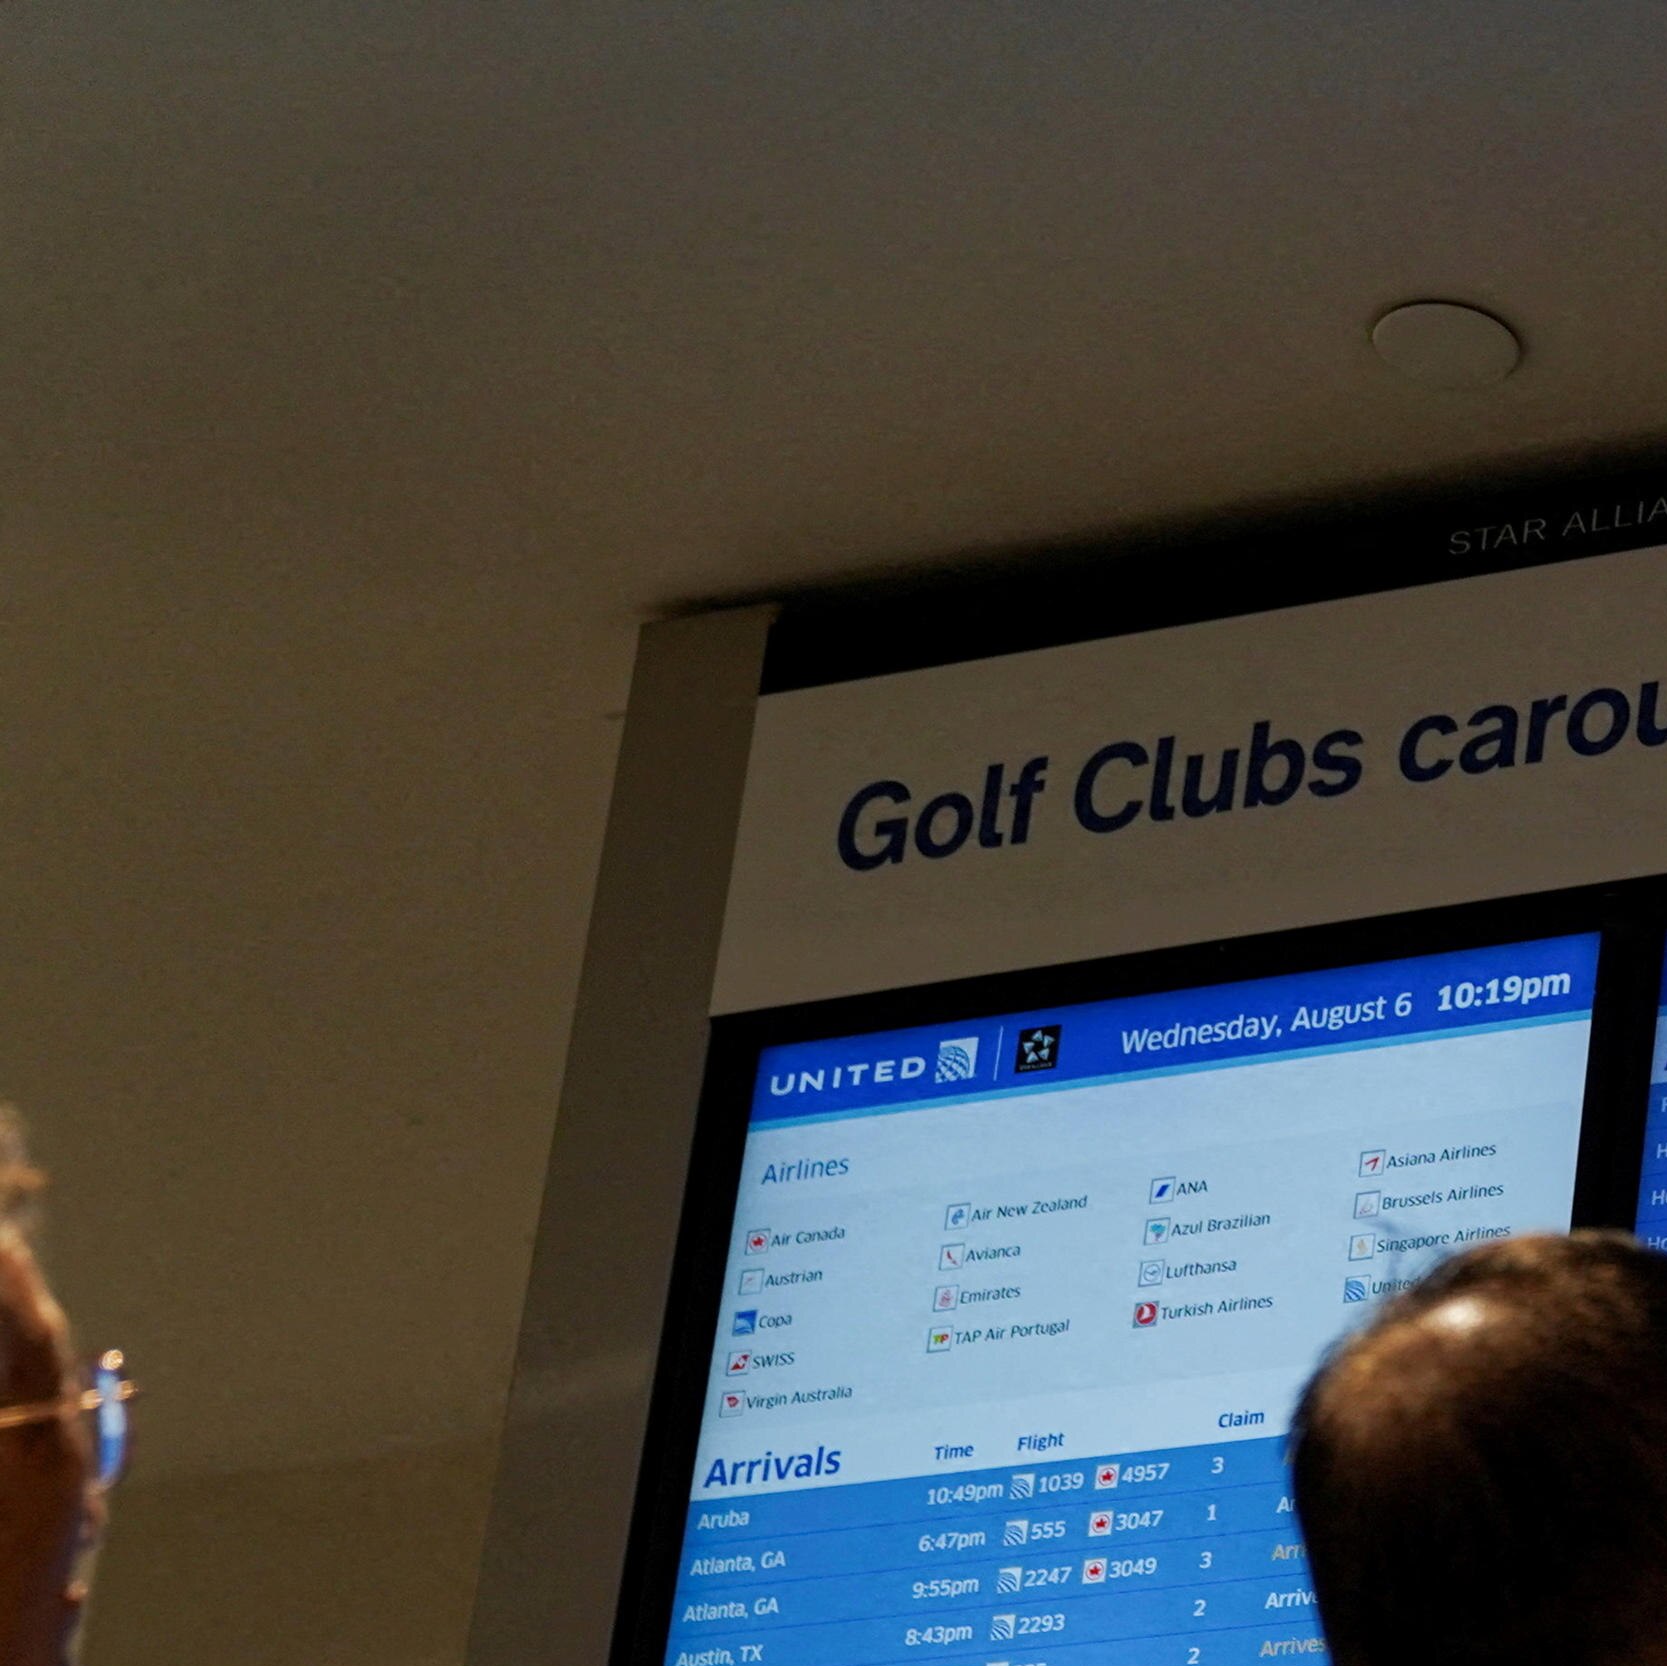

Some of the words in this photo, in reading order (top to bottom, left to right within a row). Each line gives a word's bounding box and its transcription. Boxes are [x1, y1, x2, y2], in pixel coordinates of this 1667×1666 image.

[1449, 518, 1545, 556] STAR
[837, 756, 1048, 870] Golf
[1072, 720, 1363, 835] Clubs
[1121, 1013, 1283, 1055] Wednesday,
[1289, 995, 1388, 1032] August
[1394, 991, 1413, 1018] 6
[1437, 972, 1572, 1012] 10:19pm
[770, 1056, 927, 1096] UNITED
[1385, 1152, 1436, 1169] Asiana
[1439, 1144, 1497, 1162] Airlines
[760, 1157, 850, 1185] Airlines
[1176, 1179, 1208, 1196] ANA
[1381, 1190, 1444, 1211] Brussels
[1446, 1184, 1505, 1202] Airlines
[970, 1208, 993, 1222] Air
[996, 1204, 1029, 1219] New
[1031, 1194, 1089, 1215] Zealand
[770, 1233, 792, 1248] Air
[795, 1225, 846, 1245] Canada
[1170, 1219, 1204, 1237] Azul
[1207, 1214, 1271, 1233] Brazilian
[1376, 1231, 1450, 1254] Singapore
[1453, 1225, 1511, 1243] Airlines
[964, 1245, 1022, 1263] Avianca
[764, 1269, 824, 1288] Austrian
[1165, 1259, 1238, 1280] Lufthansa
[959, 1286, 1021, 1305] Emirates
[1160, 1301, 1214, 1321] Turkish
[1216, 1296, 1274, 1314] Airlines
[758, 1314, 793, 1329] Copa
[954, 1329, 983, 1345] TAP
[984, 1326, 1007, 1342] Air
[1010, 1318, 1071, 1339] Portugal
[752, 1351, 795, 1370] SWISS
[746, 1394, 788, 1410] Virgin
[790, 1386, 853, 1405] Australia
[1217, 1411, 1265, 1429] Claim
[934, 1444, 975, 1461] Time
[1016, 1432, 1065, 1452] Flight
[702, 1445, 842, 1489] Arrivals
[1120, 1462, 1171, 1483] 4957
[1210, 1456, 1225, 1475] 3
[1038, 1471, 1085, 1494] 1039
[926, 1483, 1005, 1506] 10:49pm
[697, 1509, 751, 1530] Aruba
